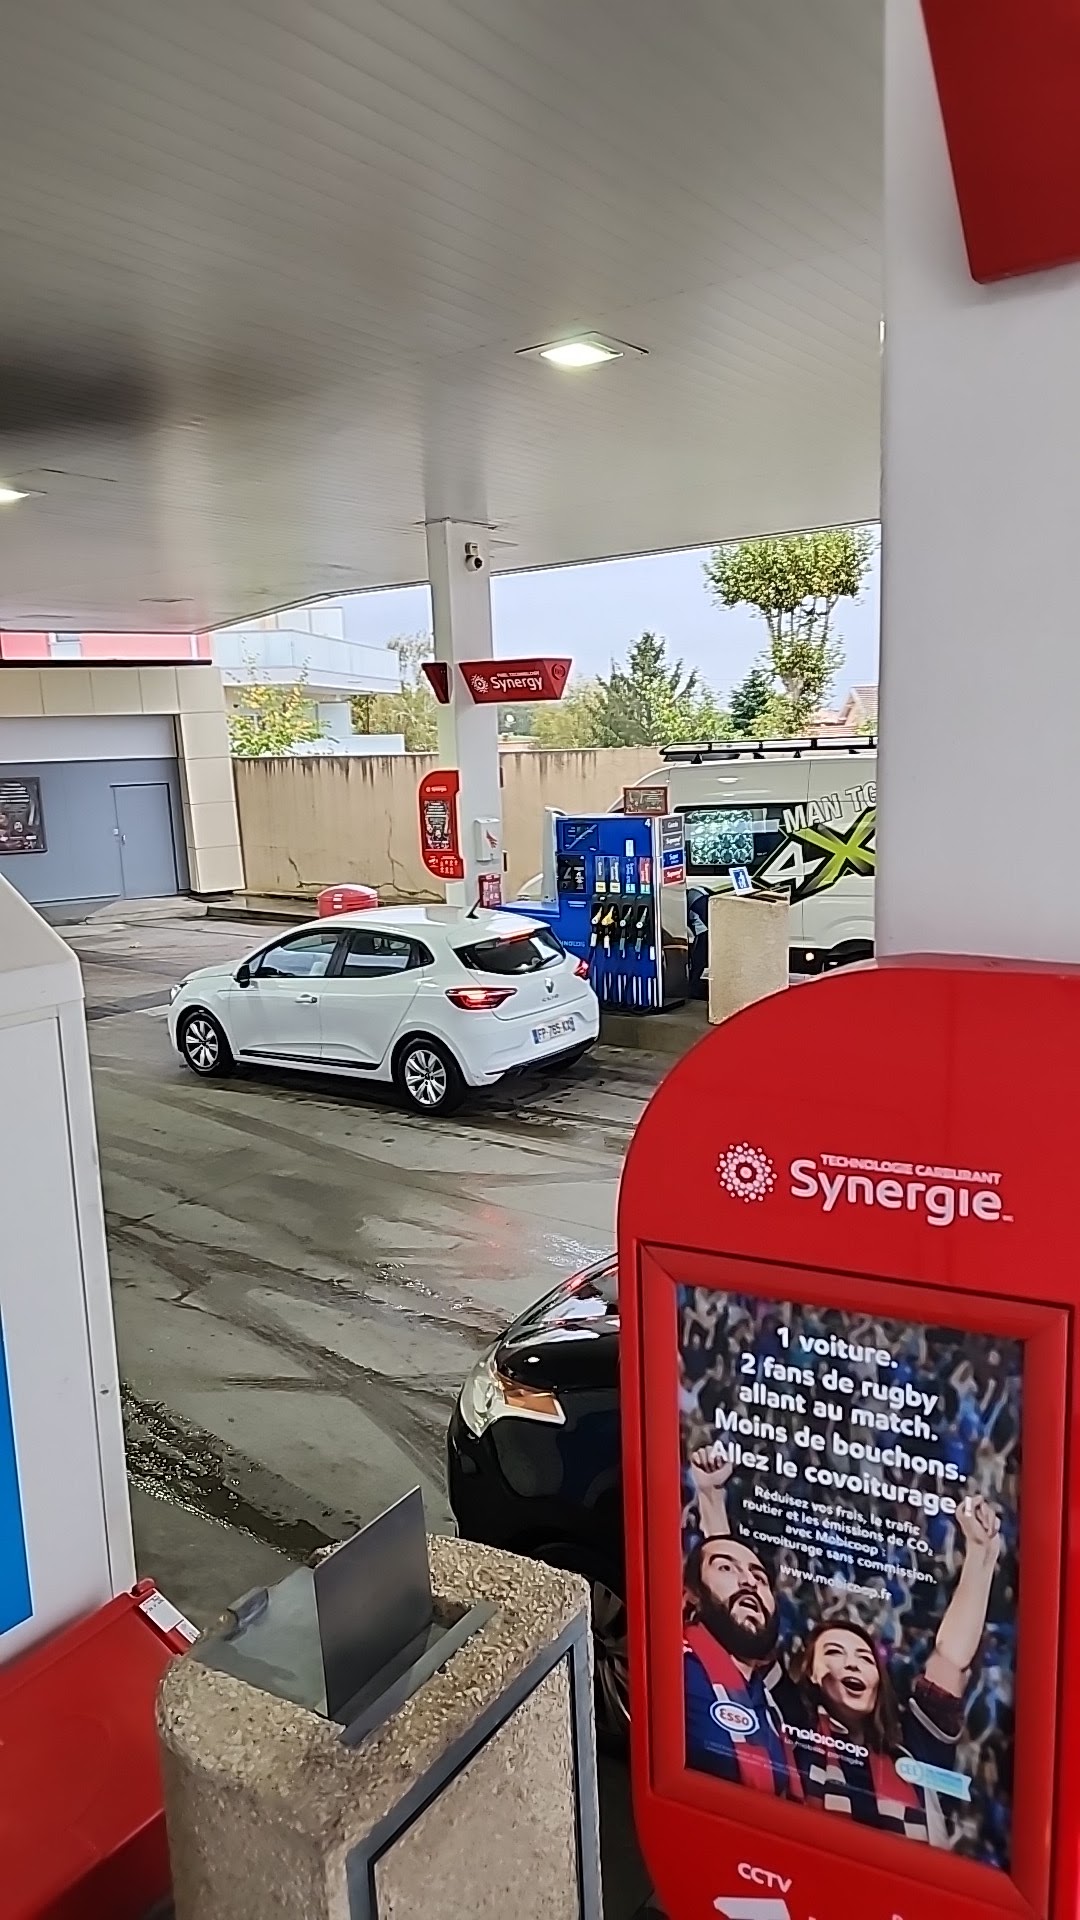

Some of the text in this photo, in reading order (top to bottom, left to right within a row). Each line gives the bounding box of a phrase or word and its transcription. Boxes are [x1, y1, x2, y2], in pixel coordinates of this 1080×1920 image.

[490, 677, 543, 692] Synergy
[645, 818, 651, 827] 4
[782, 781, 876, 833] MAN TG
[790, 1159, 1003, 1226] Synergie
[820, 1154, 1002, 1185] TECHNOLOGIE CARBURANT
[777, 1327, 899, 1369] 1 voiture.
[741, 1353, 939, 1415] 2 fans de rugby
[739, 1383, 939, 1441] allant au match.
[715, 1408, 967, 1483] Moins de bouchons.
[711, 1440, 769, 1472] Allez
[776, 1451, 798, 1479] le
[804, 1465, 957, 1516] covoiturage
[743, 1499, 783, 1517] routier
[786, 1510, 800, 1522] et
[801, 1512, 820, 1527] les
[822, 1517, 884, 1542] émissions
[886, 1533, 904, 1547] de
[755, 1485, 921, 1536] Réduisez vos frais, le trafic
[739, 1523, 938, 1585] le covoiturage sans commission.
[785, 1524, 813, 1540] avec
[815, 1529, 879, 1557] Mobicoop
[779, 1564, 894, 1601] www.mobicoop.fr
[781, 1723, 870, 1758] mobicoop
[737, 1862, 793, 1893] CCTV
